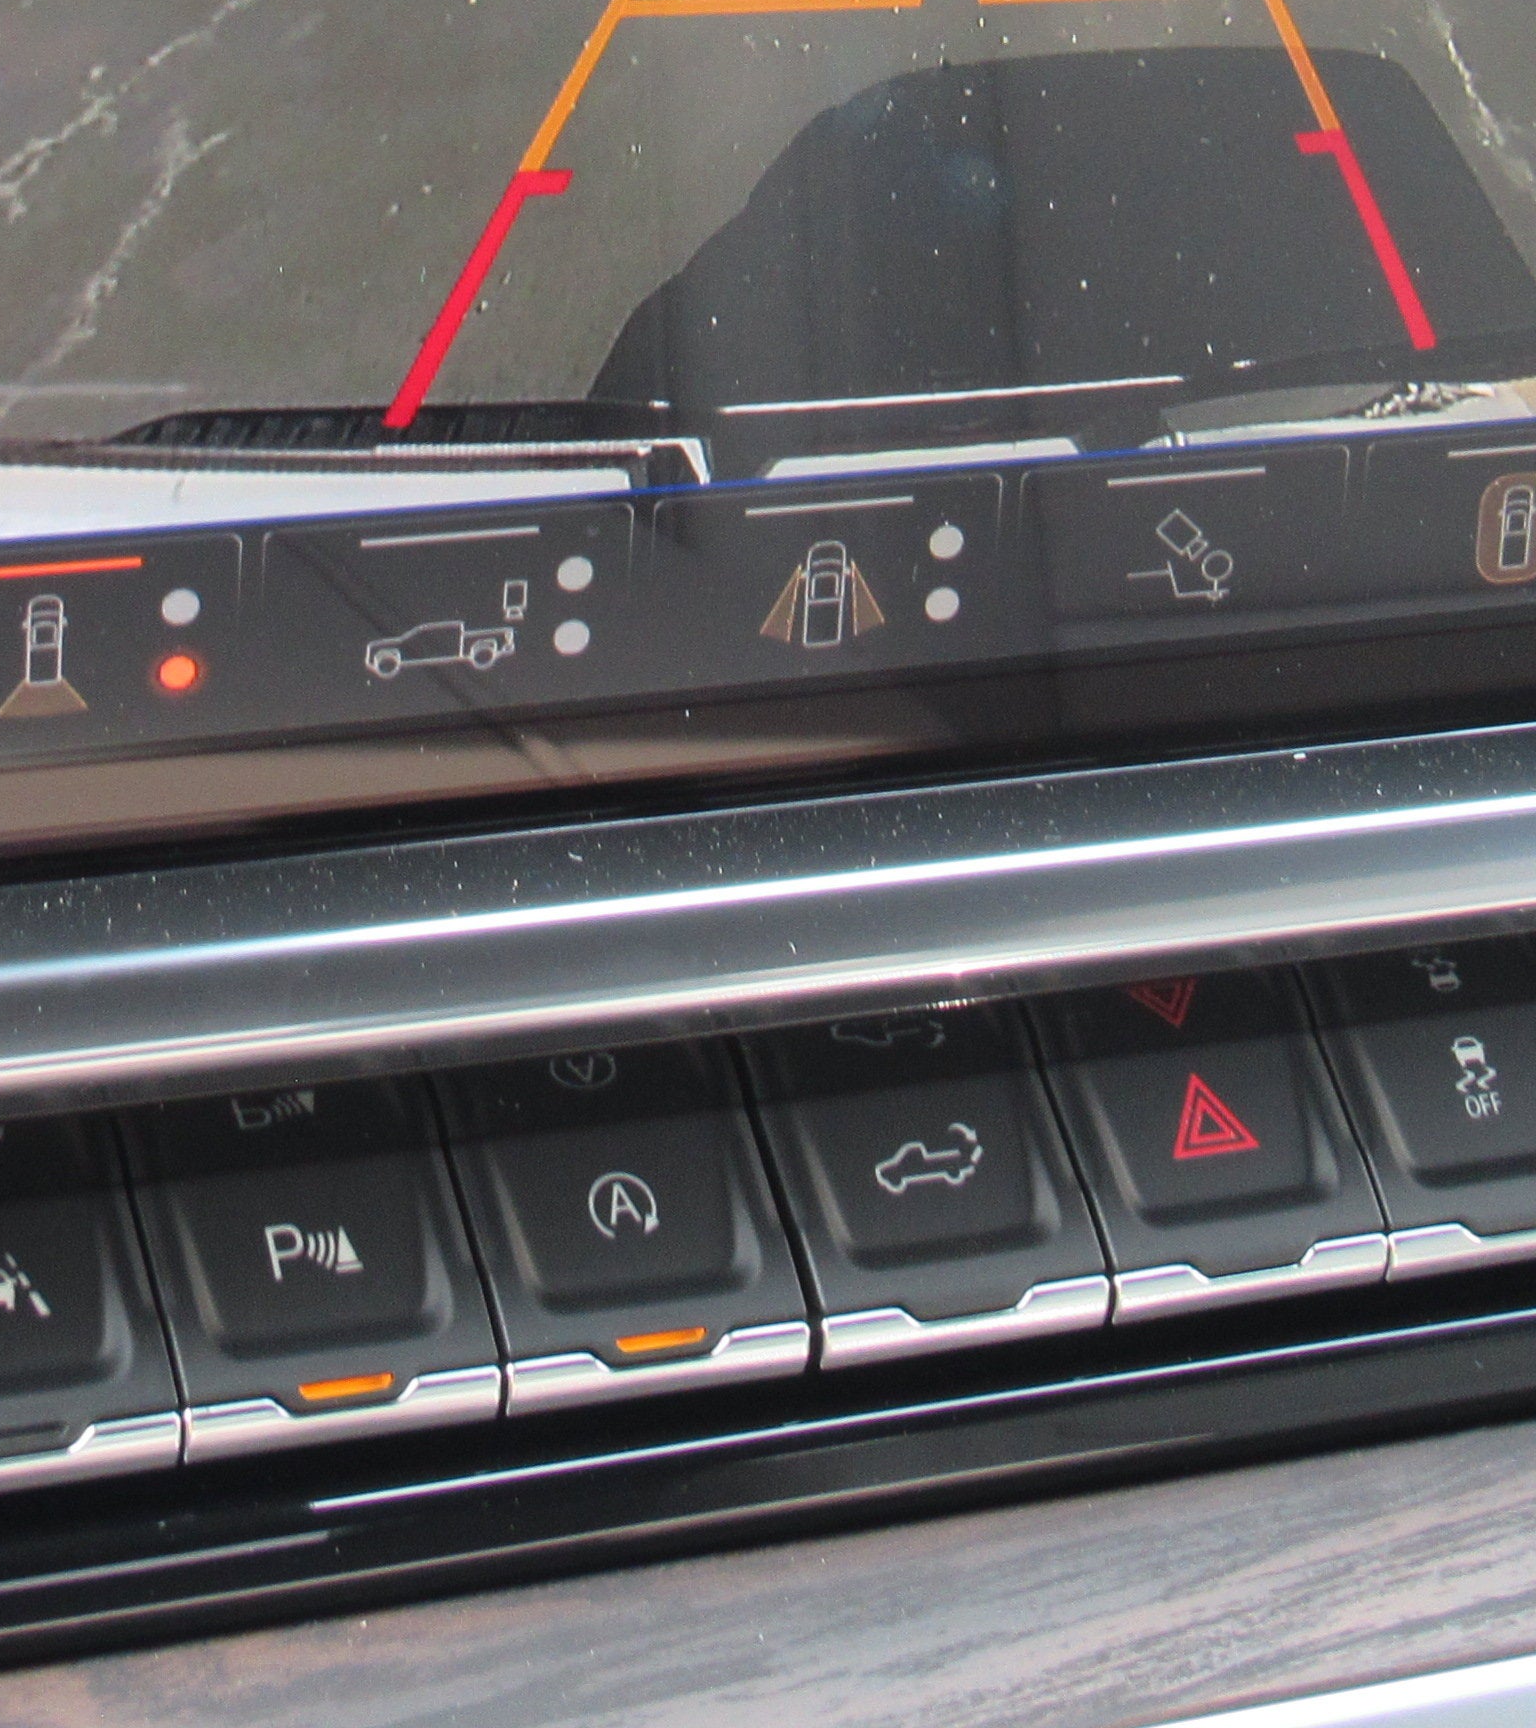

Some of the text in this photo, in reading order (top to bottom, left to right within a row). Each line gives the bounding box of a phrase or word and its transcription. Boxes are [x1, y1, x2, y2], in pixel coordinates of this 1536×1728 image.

[1465, 1092, 1502, 1119] OFF
[610, 1181, 642, 1226] A
[265, 1224, 304, 1281] P
